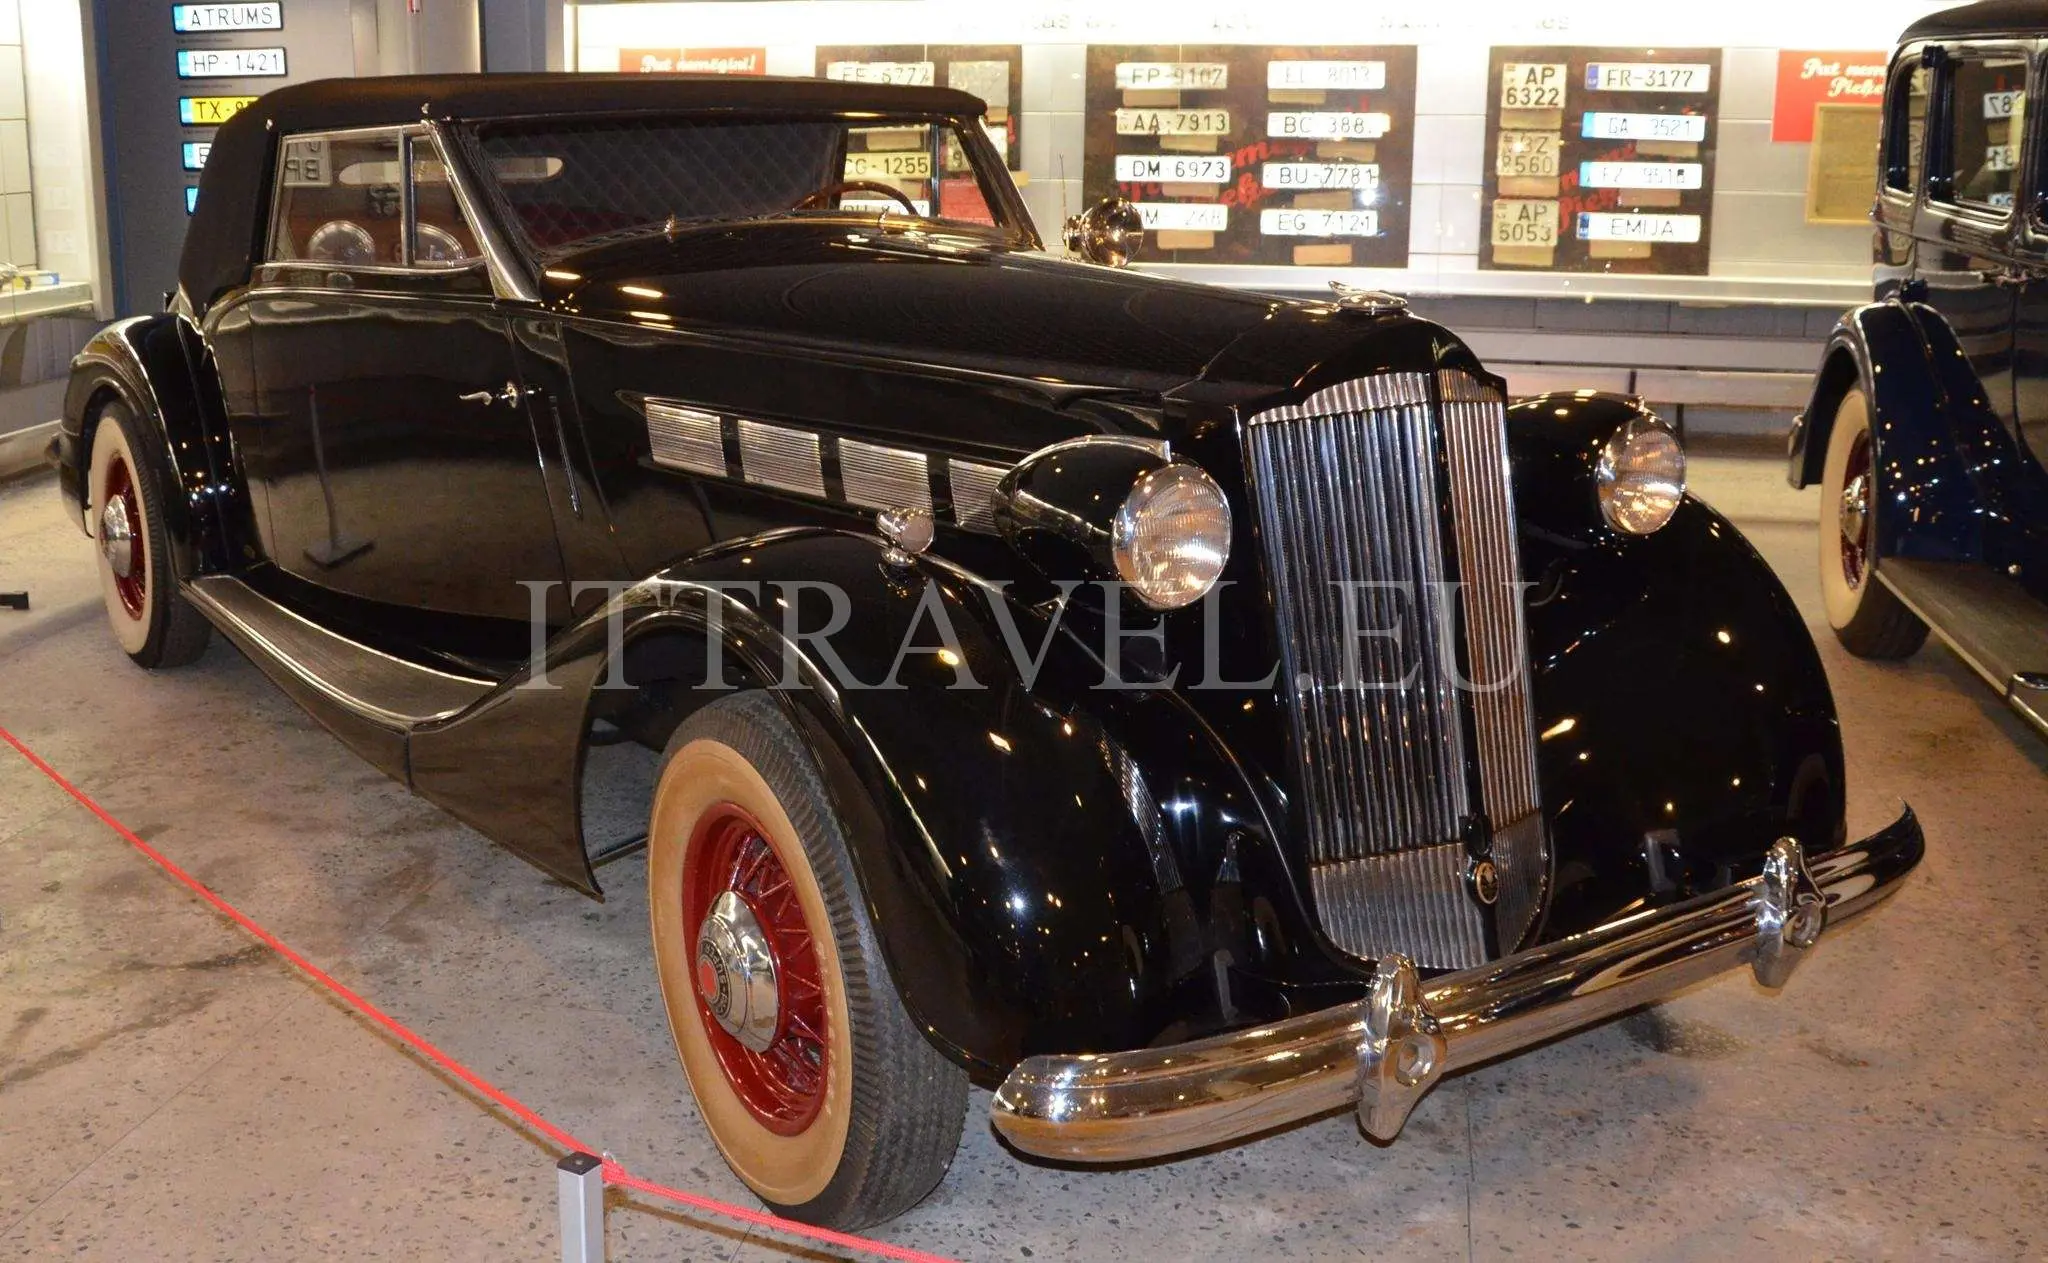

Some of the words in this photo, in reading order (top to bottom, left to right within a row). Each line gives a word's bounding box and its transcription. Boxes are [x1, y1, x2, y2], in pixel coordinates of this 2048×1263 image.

[191, 7, 273, 26] ATRUMS
[1525, 67, 1556, 85] AP
[1606, 69, 1694, 87] FR-3177
[1506, 87, 1559, 106] 6322
[1133, 113, 1226, 131] AA-7913
[1517, 204, 1548, 222] AP
[1611, 218, 1674, 237] EMIJA
